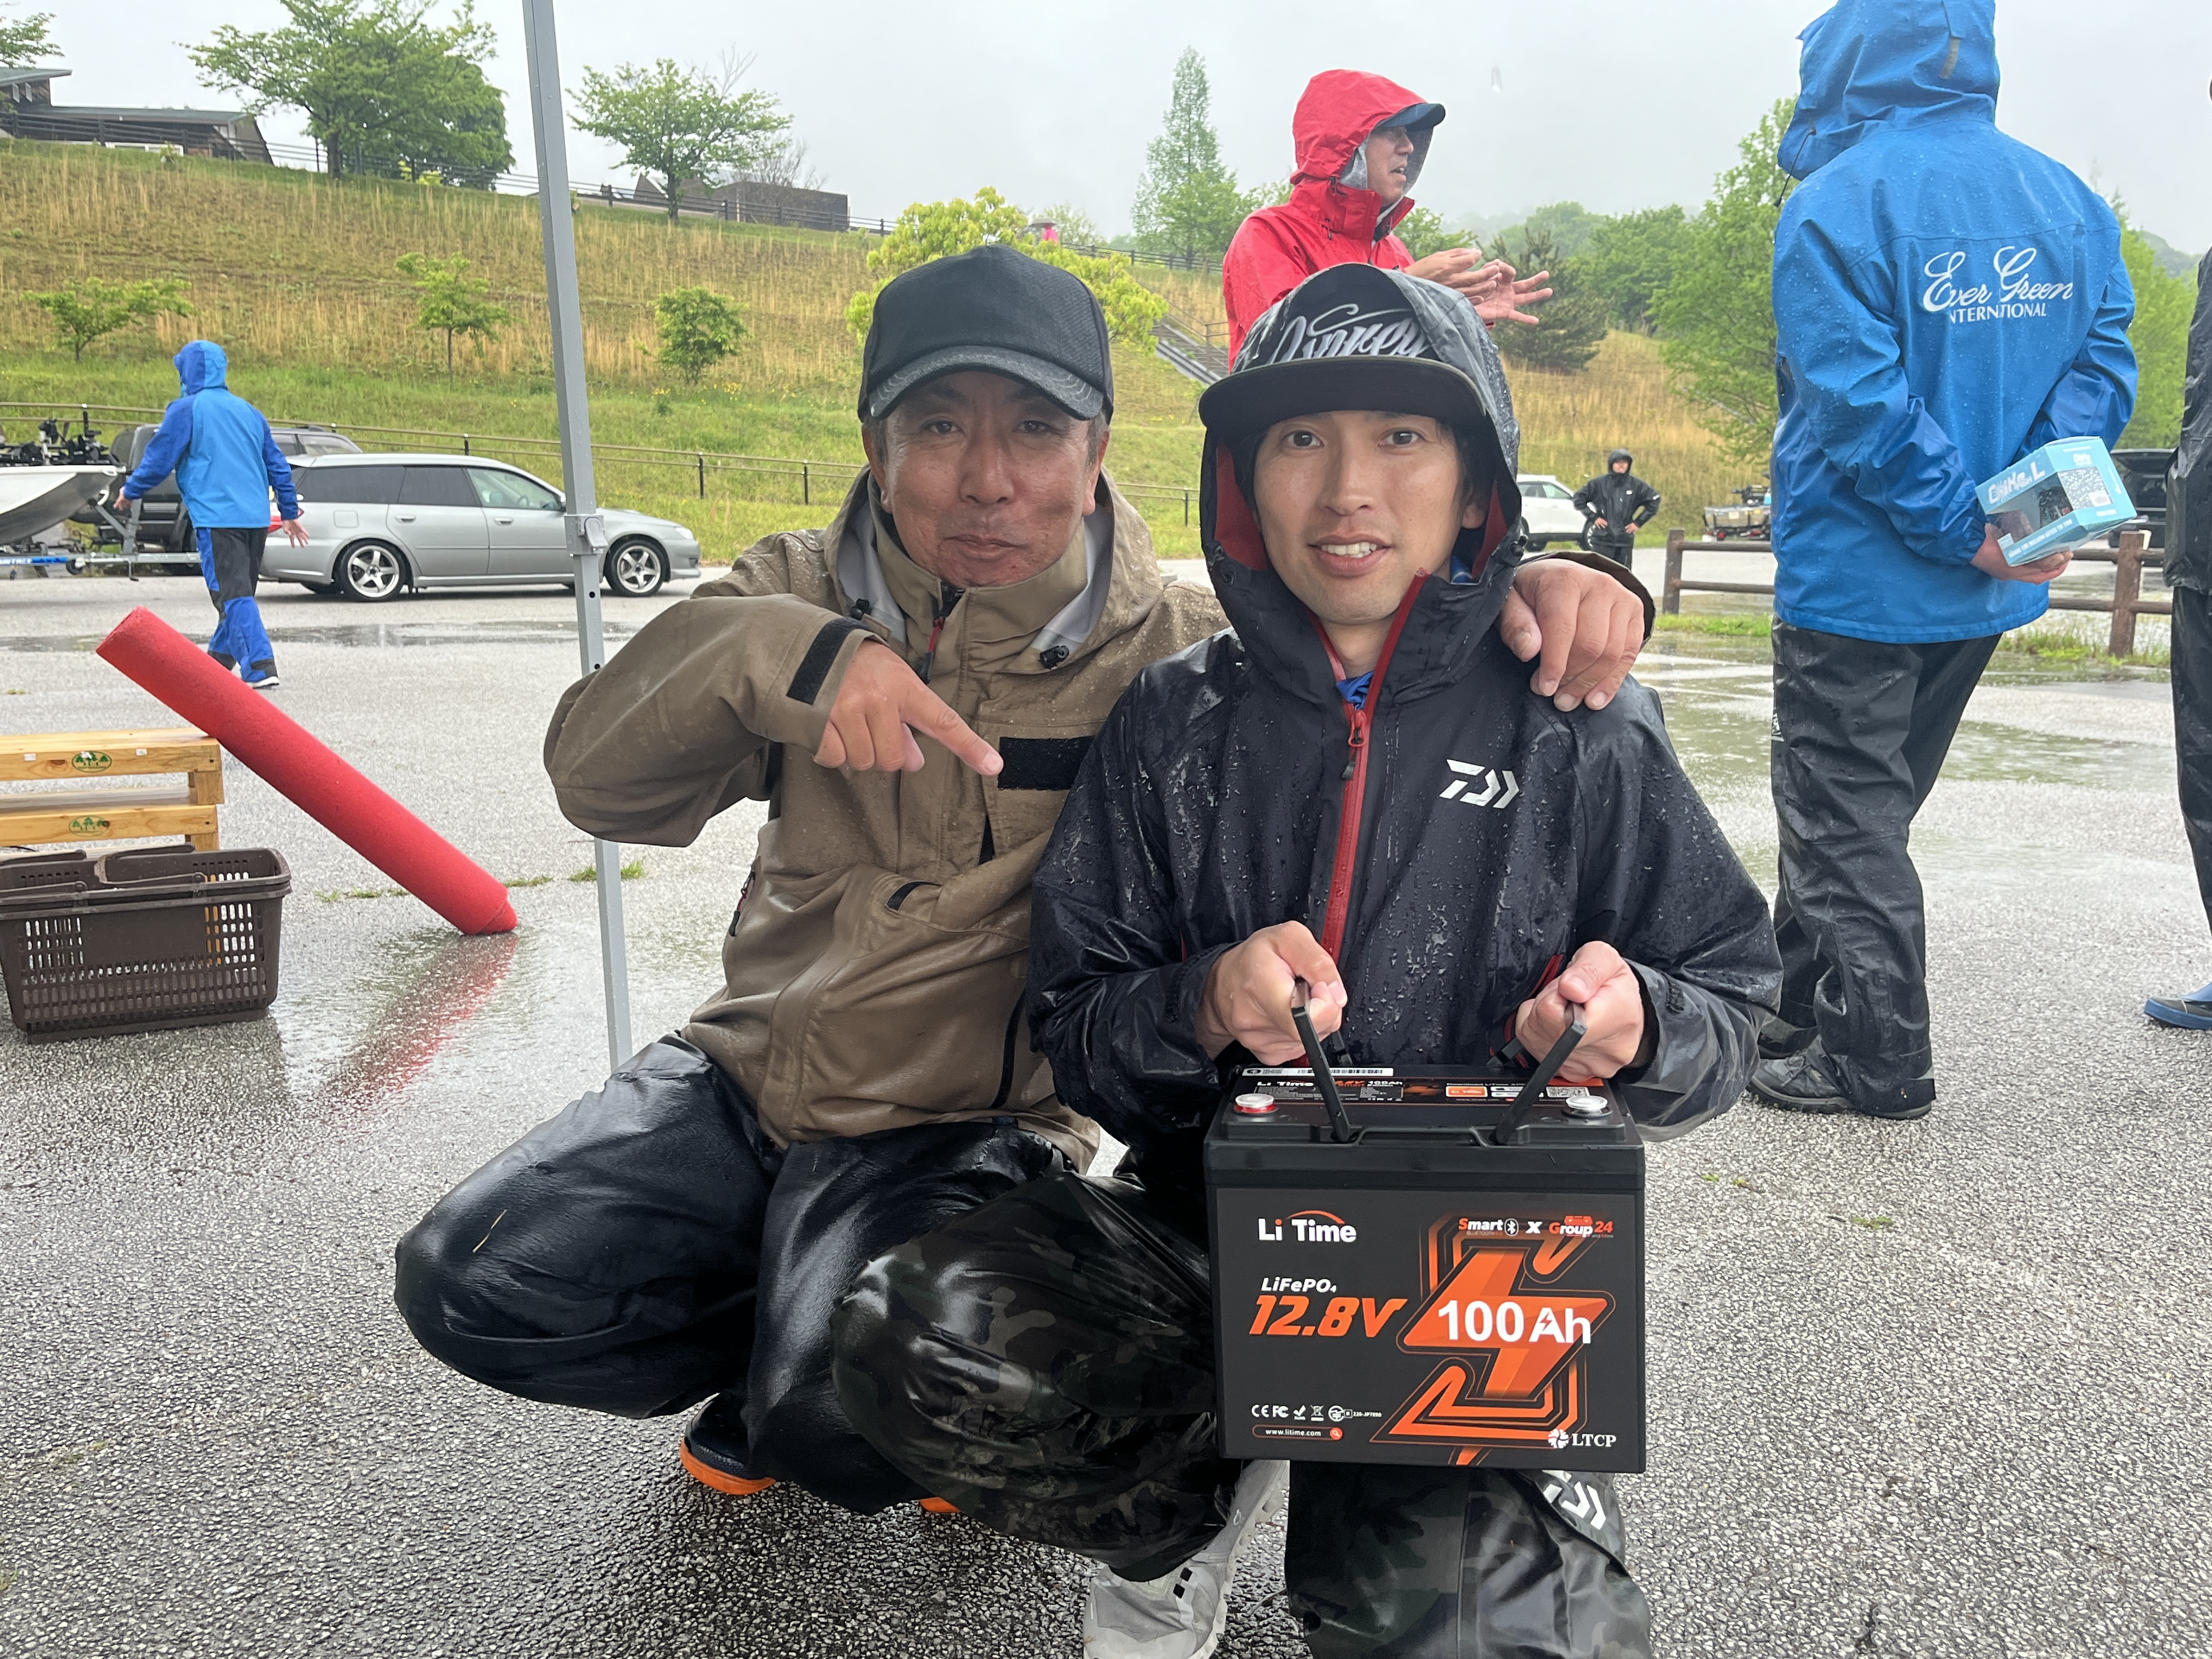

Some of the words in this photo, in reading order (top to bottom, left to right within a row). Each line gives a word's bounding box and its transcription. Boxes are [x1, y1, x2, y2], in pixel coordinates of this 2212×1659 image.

[1923, 251, 1993, 312] Ever
[1993, 246, 2073, 302] Green
[1258, 1218, 1283, 1241] Li
[1291, 1218, 1357, 1243] Time
[1458, 1217, 1504, 1231] Smart
[1249, 1295, 1409, 1338] 12.8V
[1265, 1429, 1322, 1437] www.litime.com
[1571, 1432, 1617, 1447] LTCP
